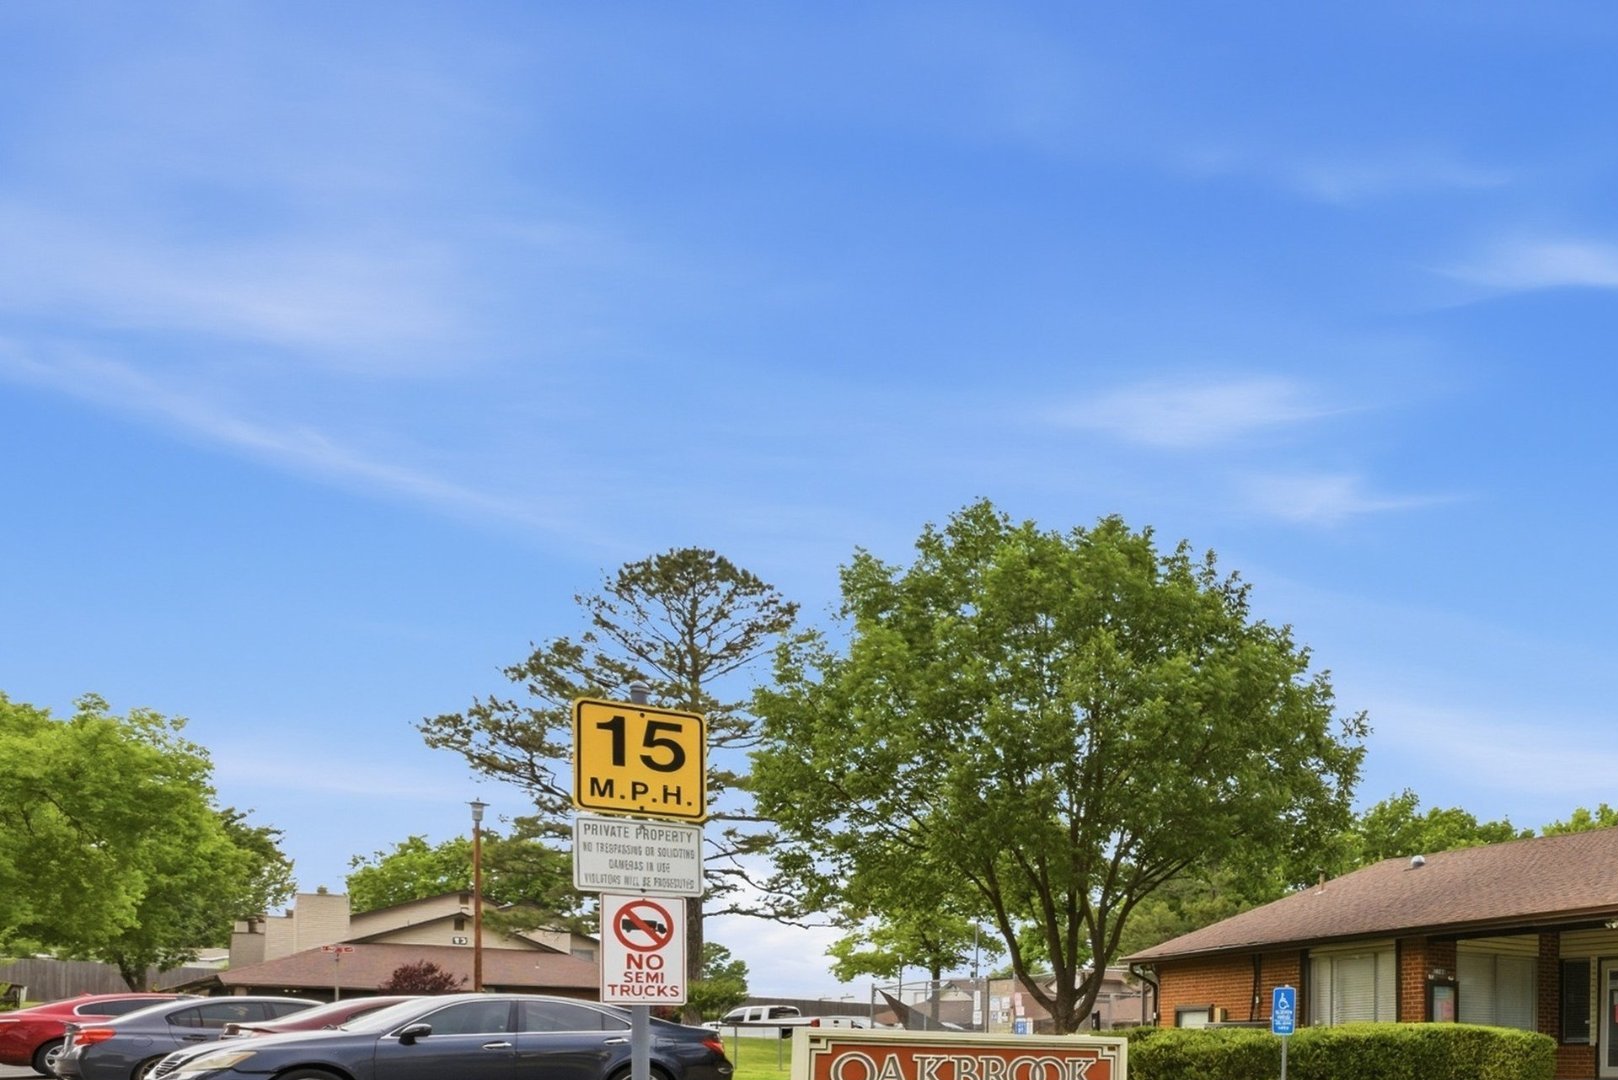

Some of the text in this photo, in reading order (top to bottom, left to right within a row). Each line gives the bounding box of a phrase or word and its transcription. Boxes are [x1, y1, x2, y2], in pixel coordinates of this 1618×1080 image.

[596, 715, 686, 773] 15
[590, 777, 693, 807] M.P.H.
[583, 823, 693, 843] PRIVATE PROPERTY
[582, 841, 593, 852] NO
[596, 842, 642, 856] TRESPASSING
[645, 846, 655, 857] OR
[646, 862, 654, 872] IN
[656, 862, 671, 873] USE
[626, 953, 664, 970] NO
[623, 971, 665, 984] SEMI
[607, 984, 680, 998] TRUCKS
